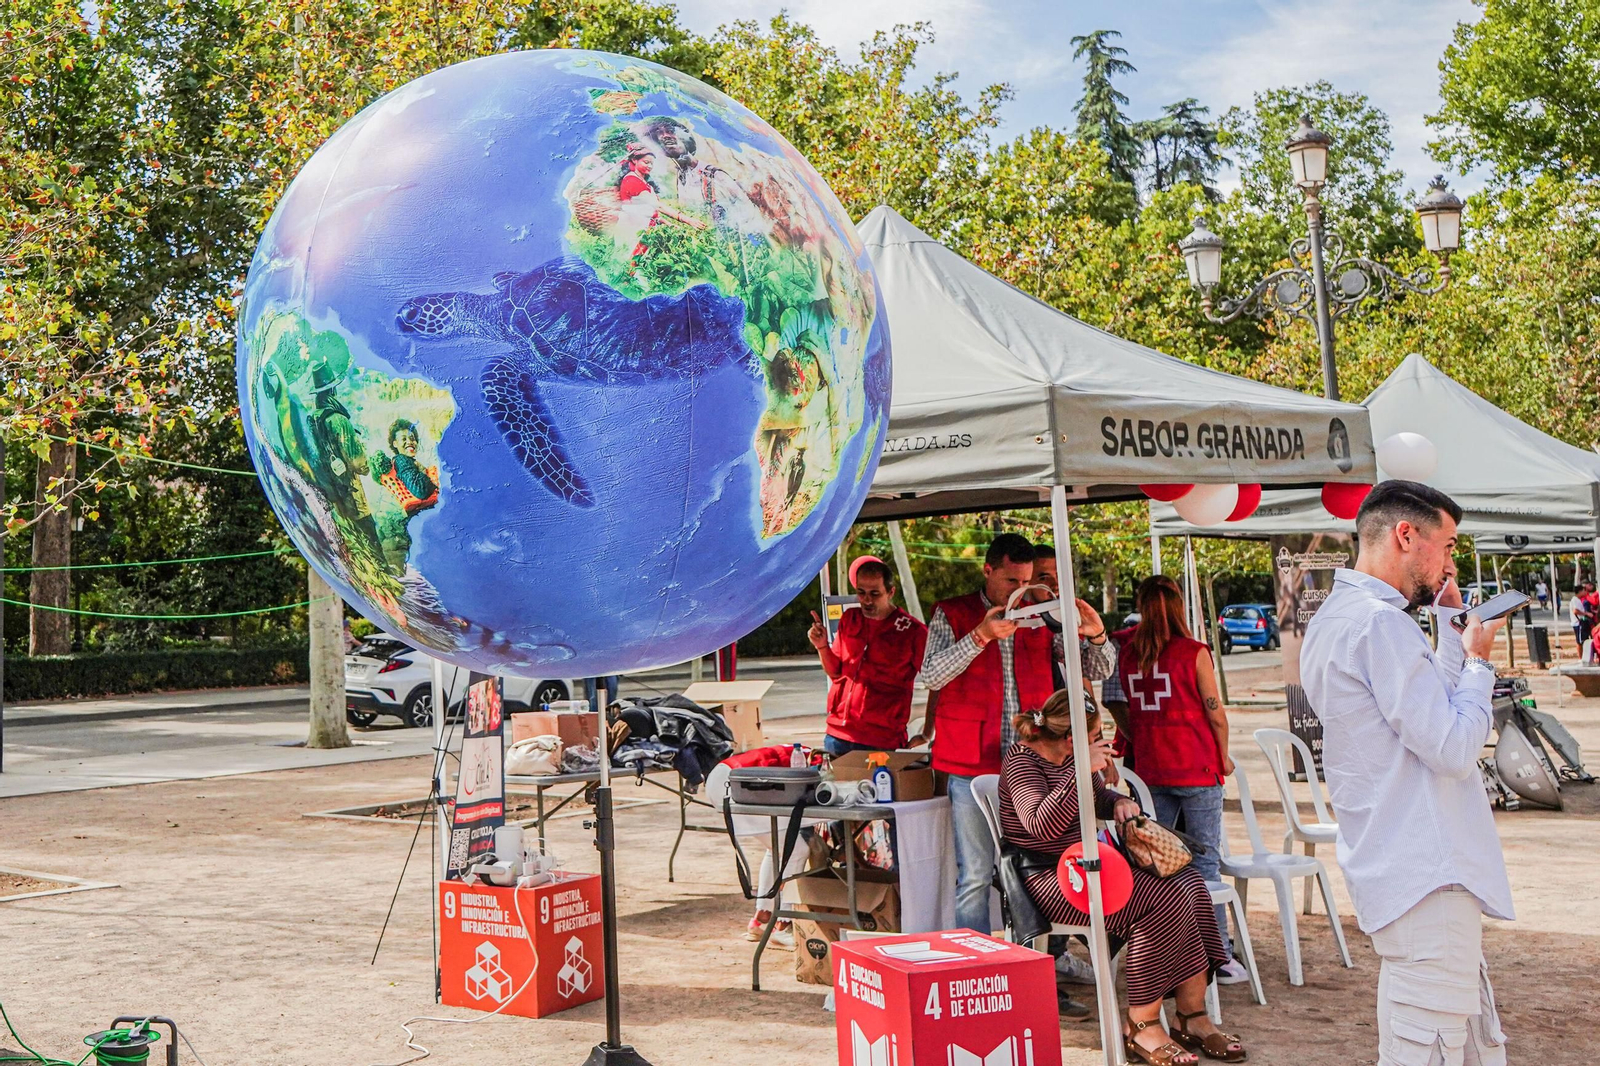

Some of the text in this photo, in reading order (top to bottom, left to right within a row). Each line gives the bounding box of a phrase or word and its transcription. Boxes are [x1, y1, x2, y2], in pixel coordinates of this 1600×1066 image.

[883, 434, 973, 452] NADA.ES
[1101, 416, 1305, 461] SABOR GRANADA
[1302, 590, 1328, 600] cursos
[444, 891, 456, 919] 9
[461, 892, 501, 910] INDUSTRIA,
[540, 896, 550, 925] 9
[585, 900, 590, 912] E
[461, 906, 510, 923] INNOVACIÓN E
[461, 920, 528, 939] INFRAESTRUCTURA
[838, 957, 848, 994] 4
[850, 963, 883, 990] EDUCACIÓN
[949, 973, 1009, 998] EDUCACIÓN
[851, 980, 886, 1010] DE CALIDAD
[924, 982, 942, 1020] 4
[950, 994, 1013, 1017] DE CALIDAD
